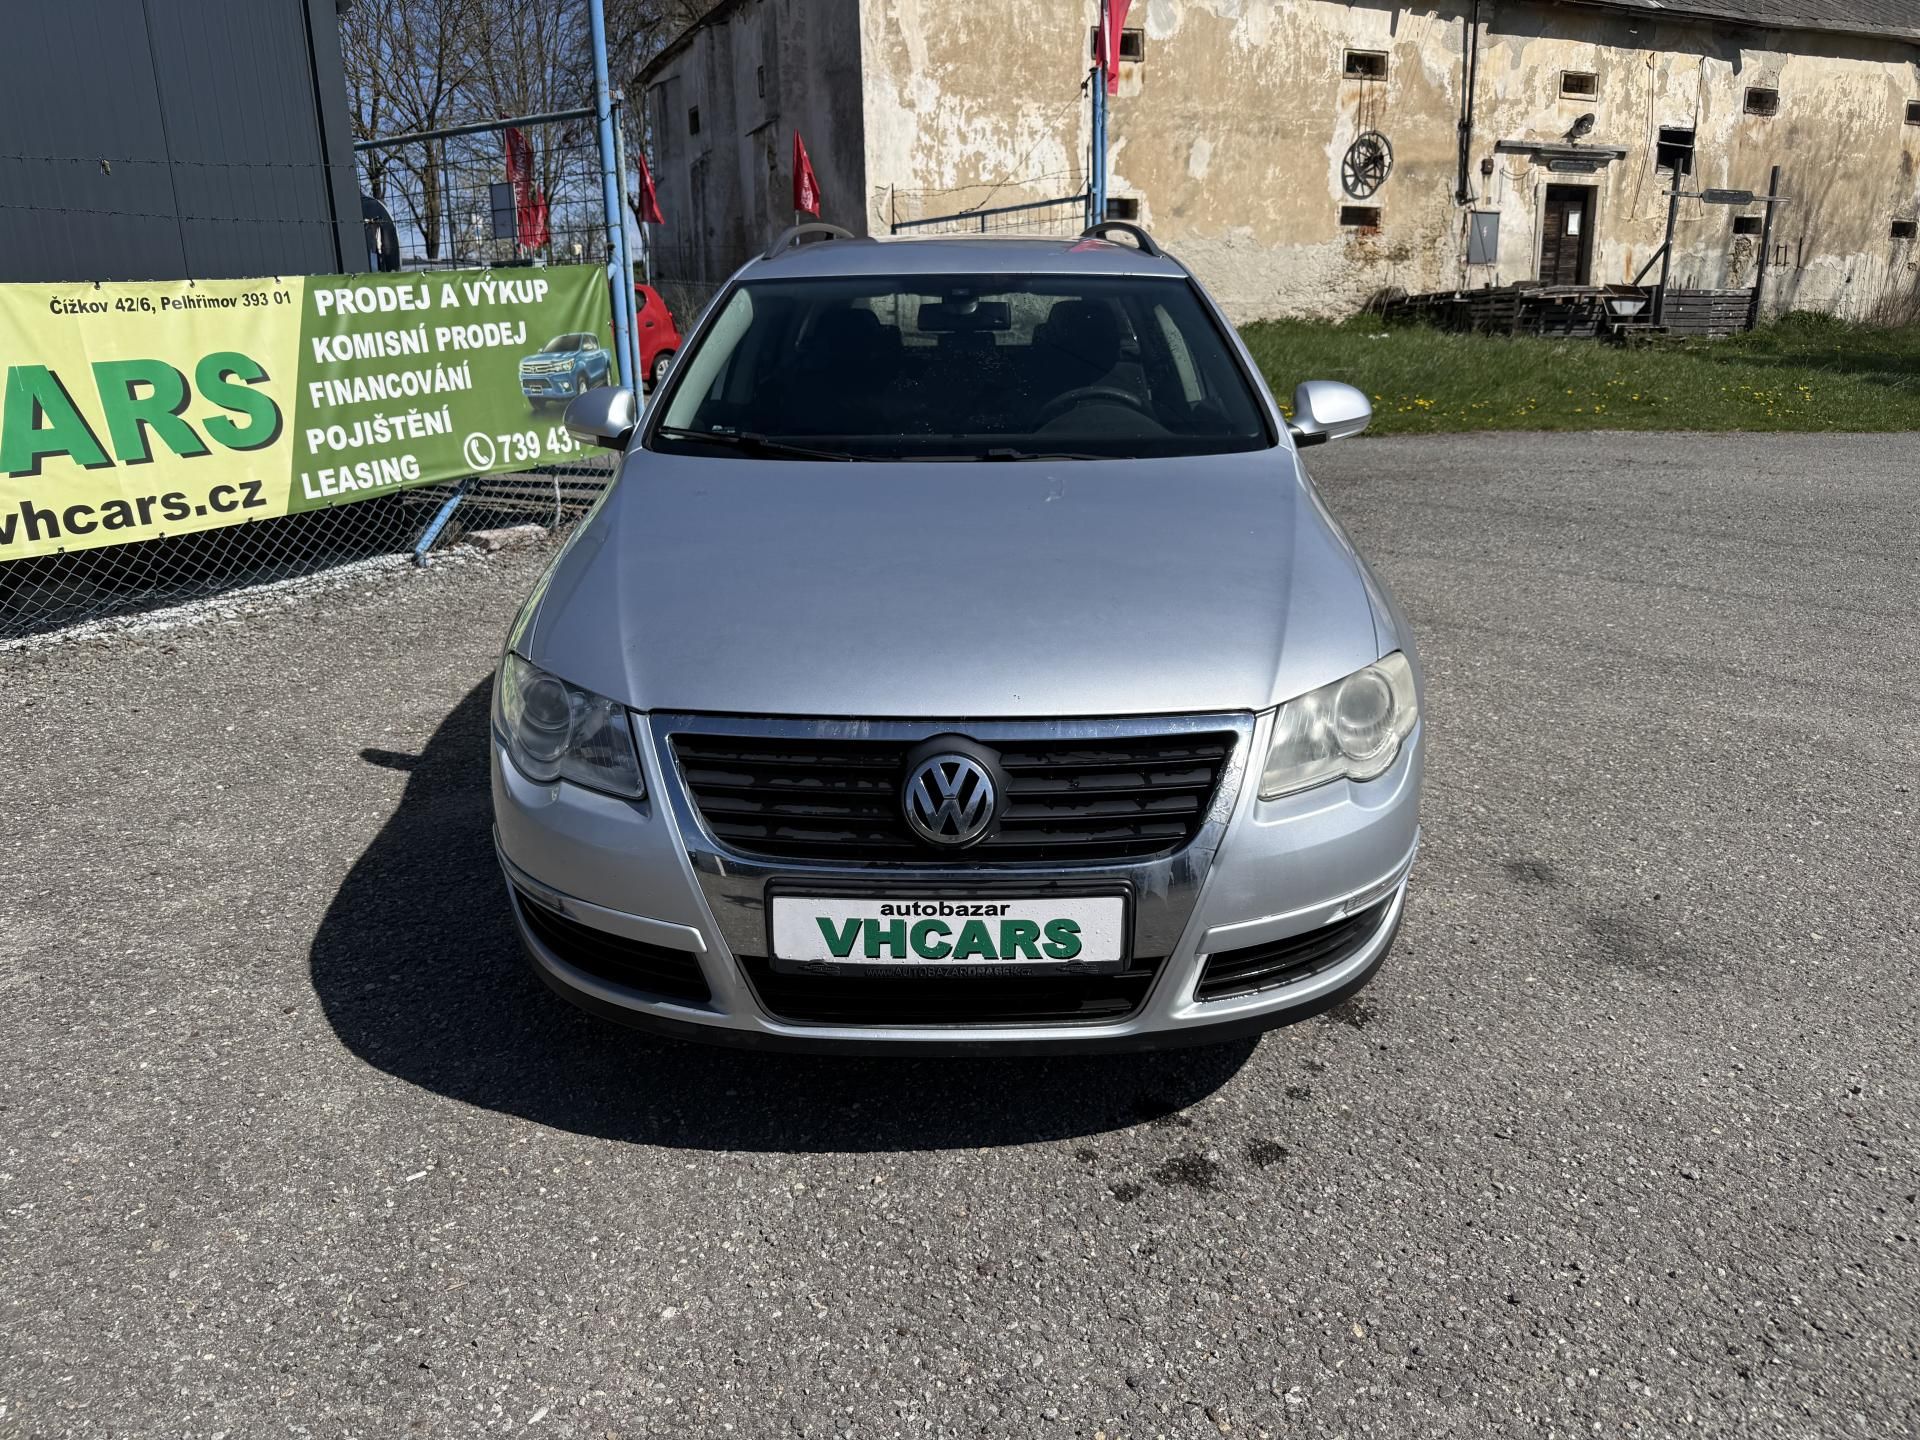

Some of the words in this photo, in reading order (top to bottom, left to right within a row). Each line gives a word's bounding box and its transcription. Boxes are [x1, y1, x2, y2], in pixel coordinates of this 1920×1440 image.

[50, 296, 108, 315] Čížkov
[115, 297, 156, 314] 42/6,
[161, 295, 237, 311] Pelhřimov
[242, 291, 269, 306] 393
[273, 291, 291, 305] 01
[314, 284, 431, 316] PRODEJ
[441, 284, 460, 308] A
[463, 275, 549, 306] VÝKUP
[312, 323, 429, 363] KOMISNÍ
[435, 321, 527, 352] PRODEJ
[309, 360, 473, 408] FINANCOVÁNÍ
[306, 404, 453, 454] POJIŠTĚNÍ
[496, 430, 541, 463] 739
[546, 426, 581, 454] 43
[301, 455, 421, 500] LEASING
[880, 901, 1010, 917] autobazar
[816, 917, 1082, 961] VHCARS
